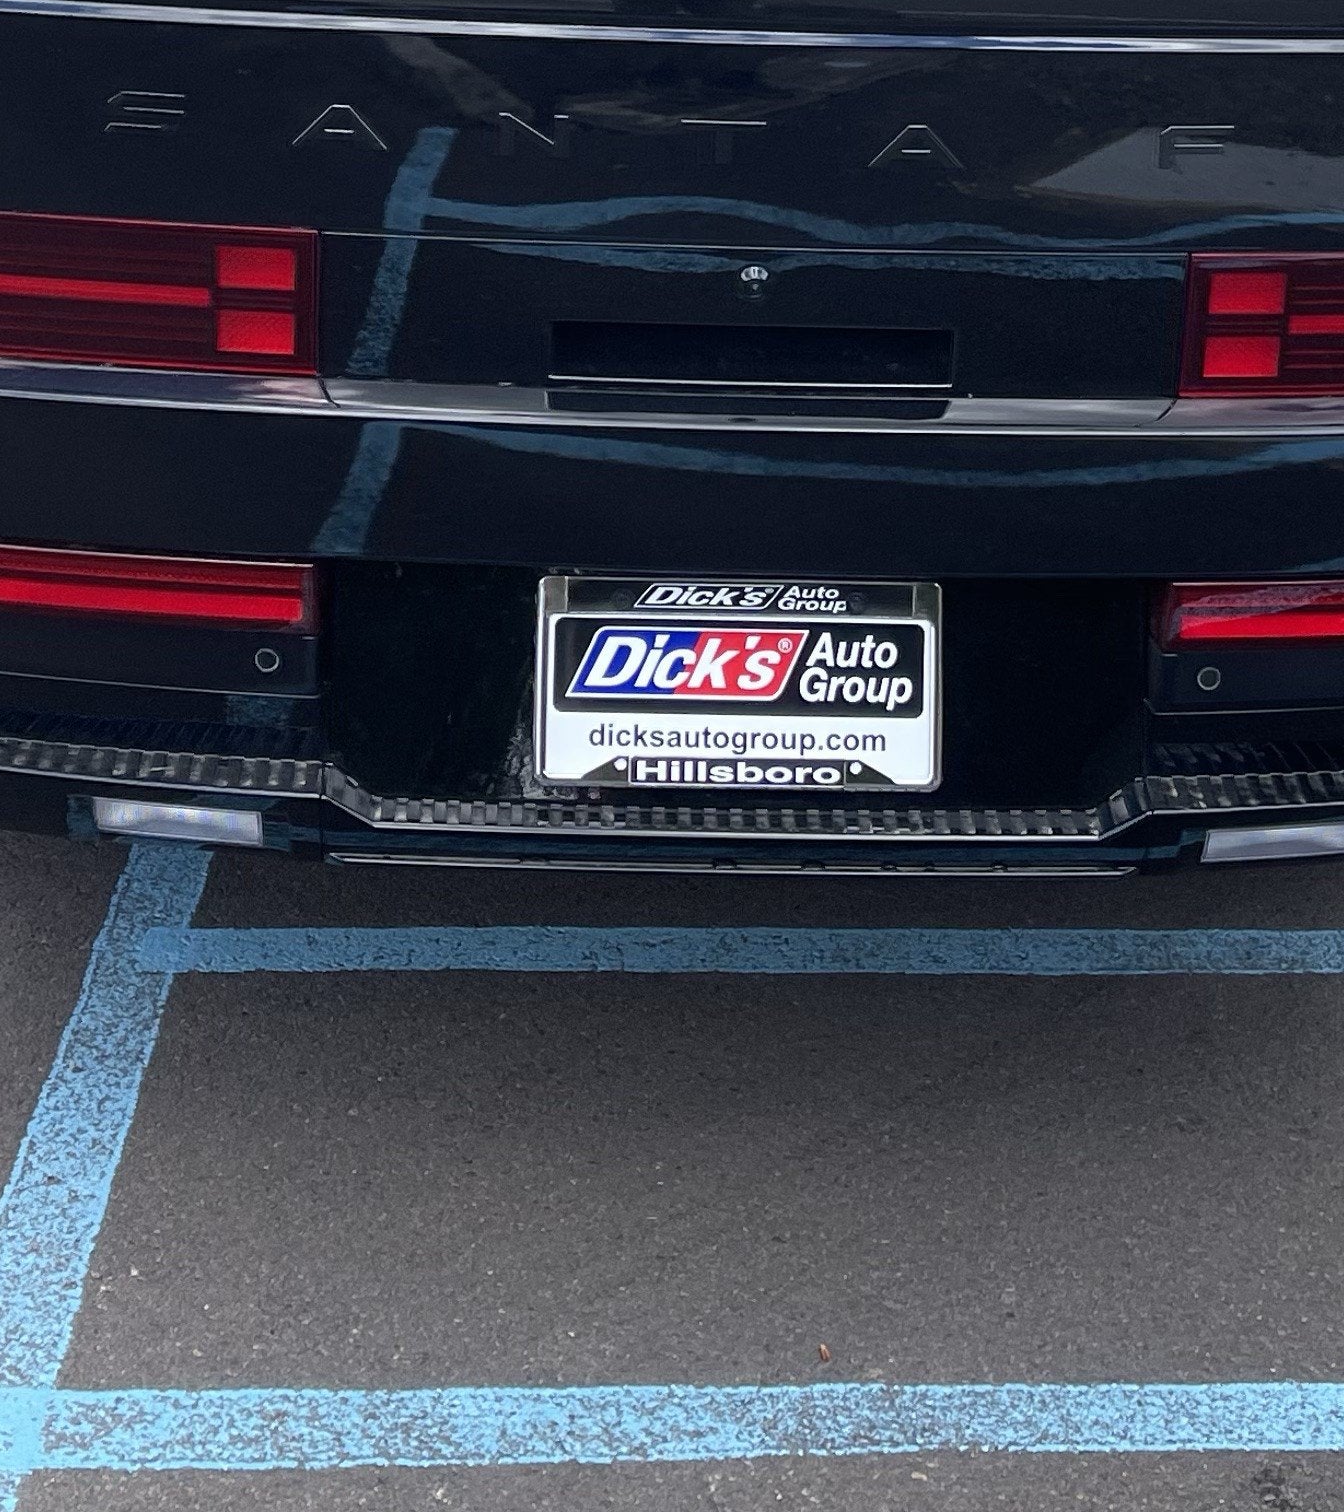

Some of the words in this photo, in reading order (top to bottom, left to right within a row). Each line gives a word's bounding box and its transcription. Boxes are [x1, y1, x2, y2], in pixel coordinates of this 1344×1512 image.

[103, 90, 965, 170] SANTA
[645, 586, 774, 607] Dick's
[784, 586, 840, 600] Auto
[778, 598, 847, 613] Group
[584, 635, 782, 690] Dick's
[805, 632, 899, 669] Auto
[799, 668, 913, 711] Group
[588, 724, 887, 755] dicksautogroup.com
[635, 761, 841, 784] Hillsboro
